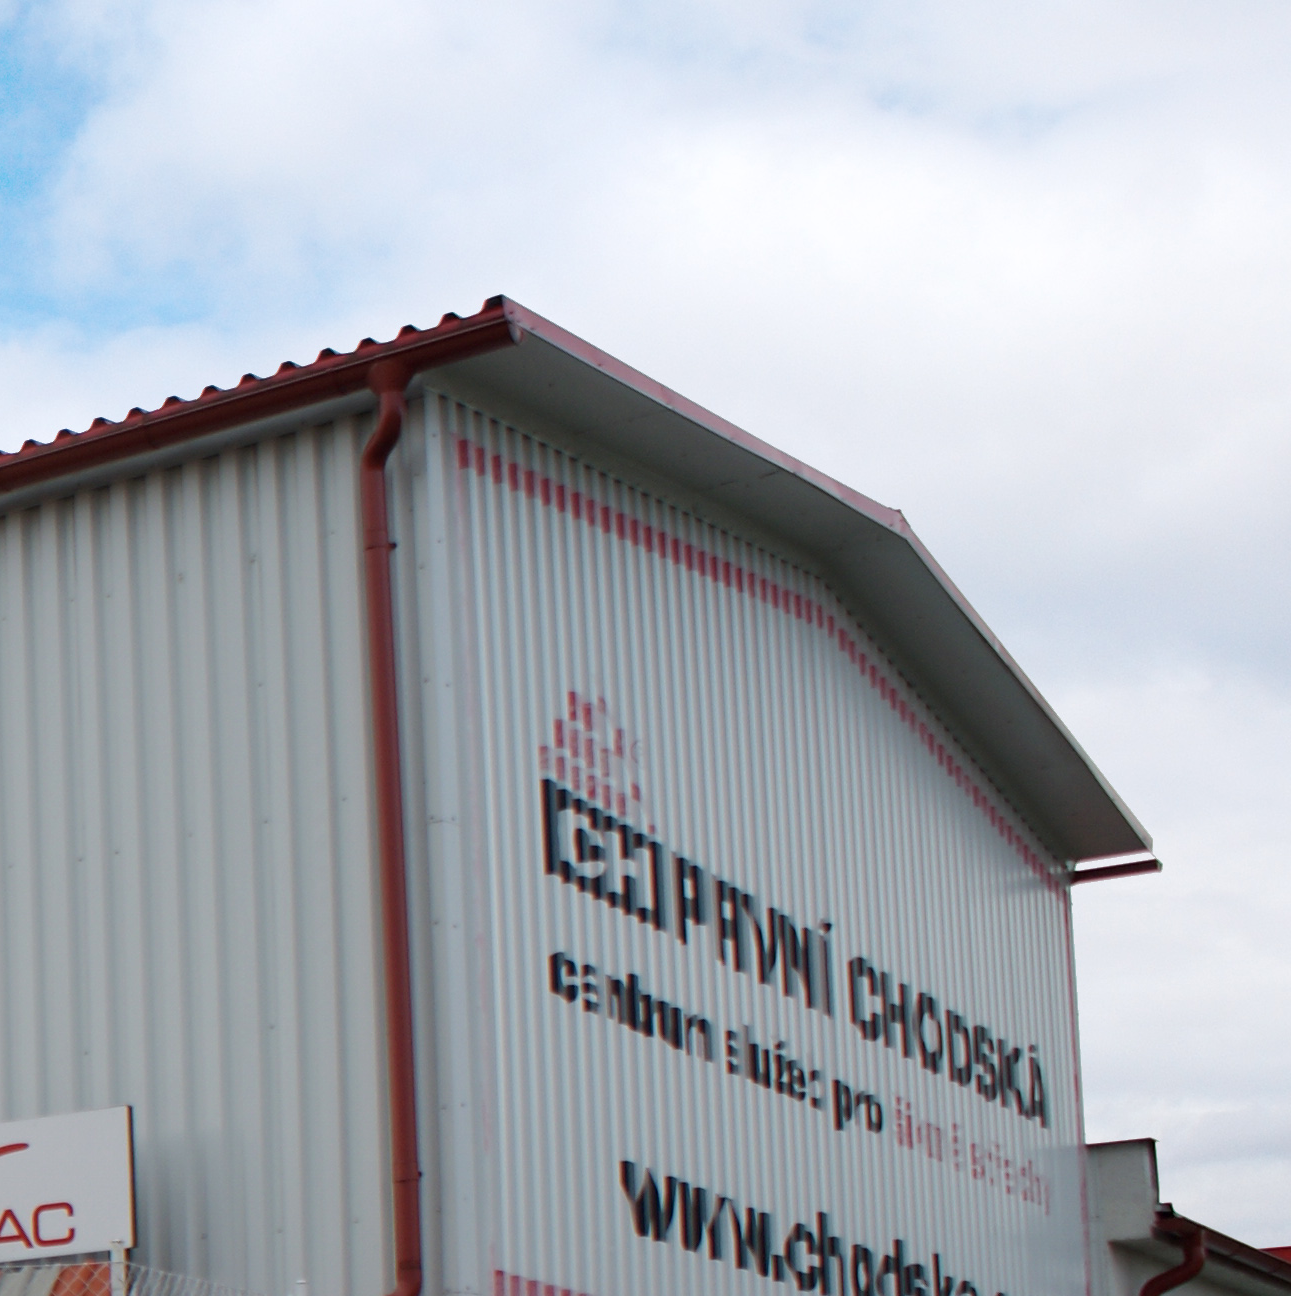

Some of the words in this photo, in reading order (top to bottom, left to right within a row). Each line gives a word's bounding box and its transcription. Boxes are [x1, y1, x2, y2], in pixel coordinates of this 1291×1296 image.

[674, 851, 834, 1018] PRVNÍ
[848, 956, 1050, 1129] CHODSKÁ
[831, 1078, 885, 1134] pro
